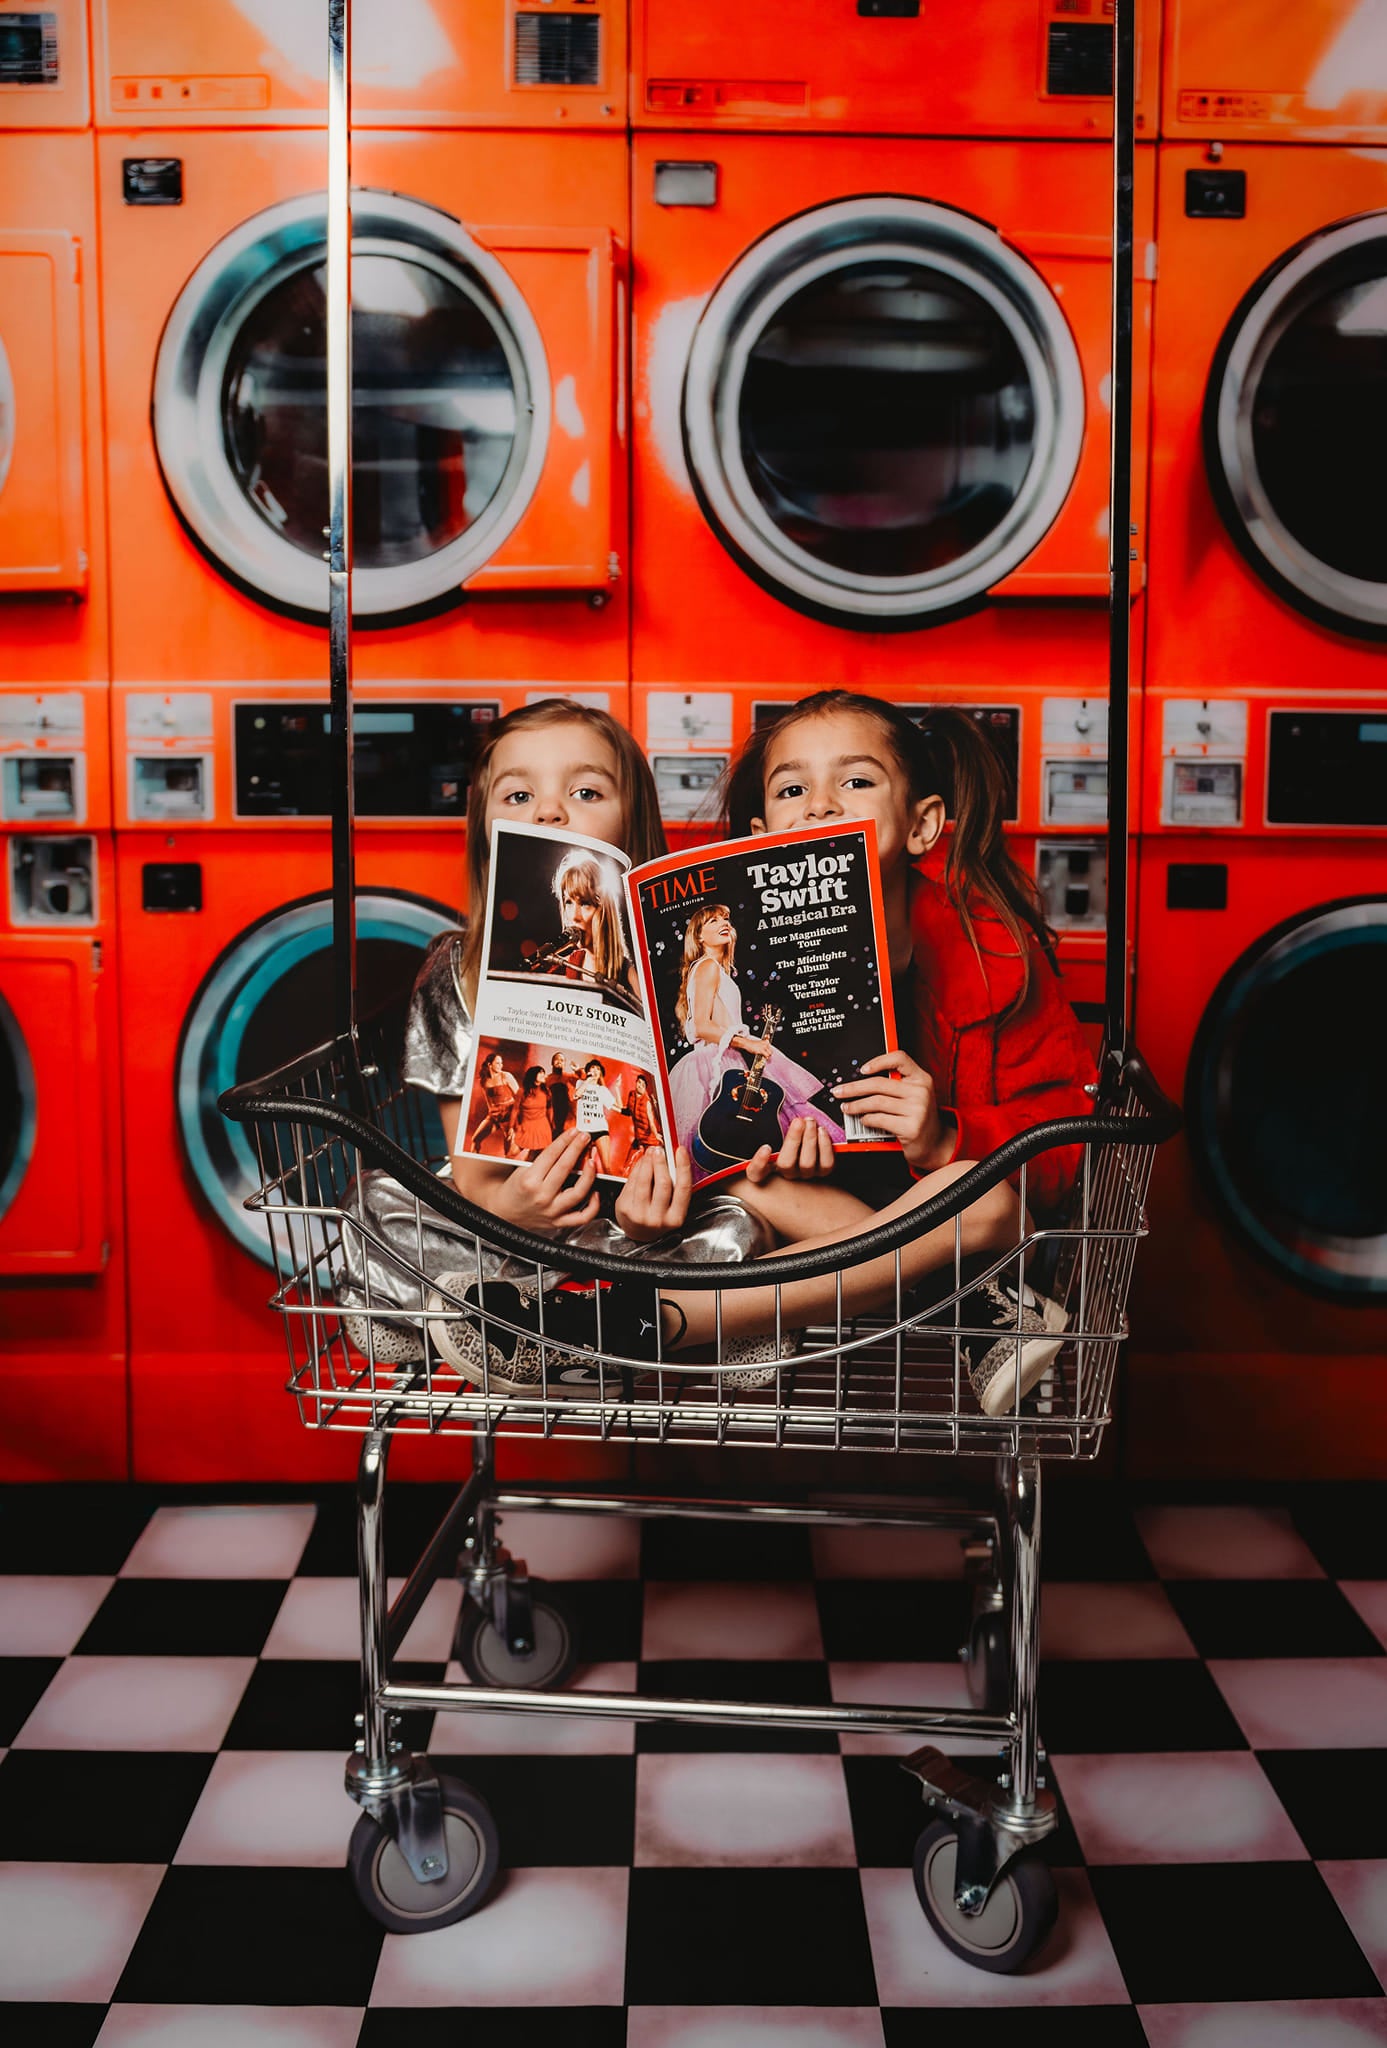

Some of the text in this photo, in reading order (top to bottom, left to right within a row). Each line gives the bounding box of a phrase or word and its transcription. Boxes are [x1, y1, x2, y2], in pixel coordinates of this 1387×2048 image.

[746, 853, 855, 889] Taylor
[643, 866, 719, 909] TIME
[760, 877, 849, 914] Swift
[659, 896, 705, 915] SPECIAL EDITION
[757, 904, 857, 931] A Magical Era
[769, 924, 848, 946] Her Magnificent
[797, 938, 822, 949] Tour
[775, 950, 847, 970] The Midnights
[796, 963, 830, 975] Album
[787, 977, 840, 992] The Taylor
[793, 986, 837, 1000] Versions
[493, 1015, 525, 1025] powerful
[507, 1006, 528, 1017] Taylor
[529, 1011, 548, 1020] Swift
[546, 999, 627, 1027] LOVE STORY
[792, 1013, 846, 1028] and the Lives
[799, 1007, 836, 1019] Her Fans
[795, 1020, 843, 1035] She's Lifted
